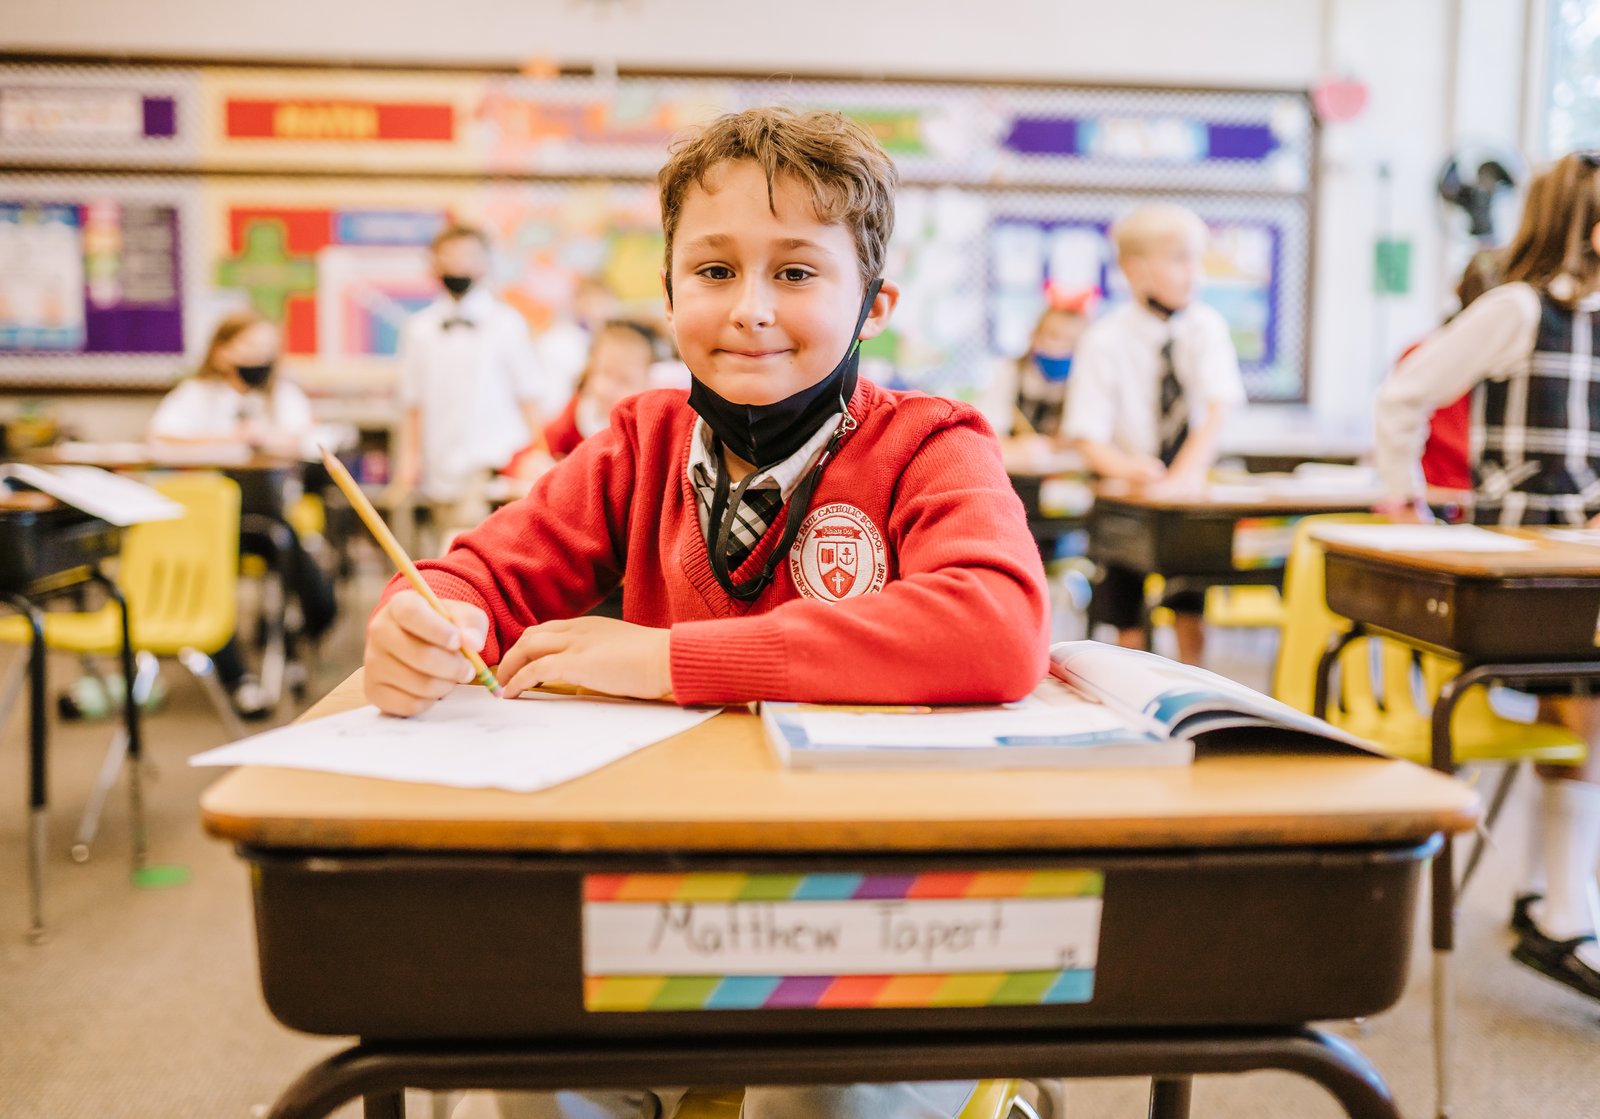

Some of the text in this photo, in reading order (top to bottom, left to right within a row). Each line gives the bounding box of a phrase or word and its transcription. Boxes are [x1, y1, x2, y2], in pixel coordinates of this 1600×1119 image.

[799, 514, 818, 537] PAUL
[817, 505, 862, 519] CATHOLIC
[860, 515, 884, 554] SCHOOL
[648, 898, 1004, 964] Matthew Tapert
